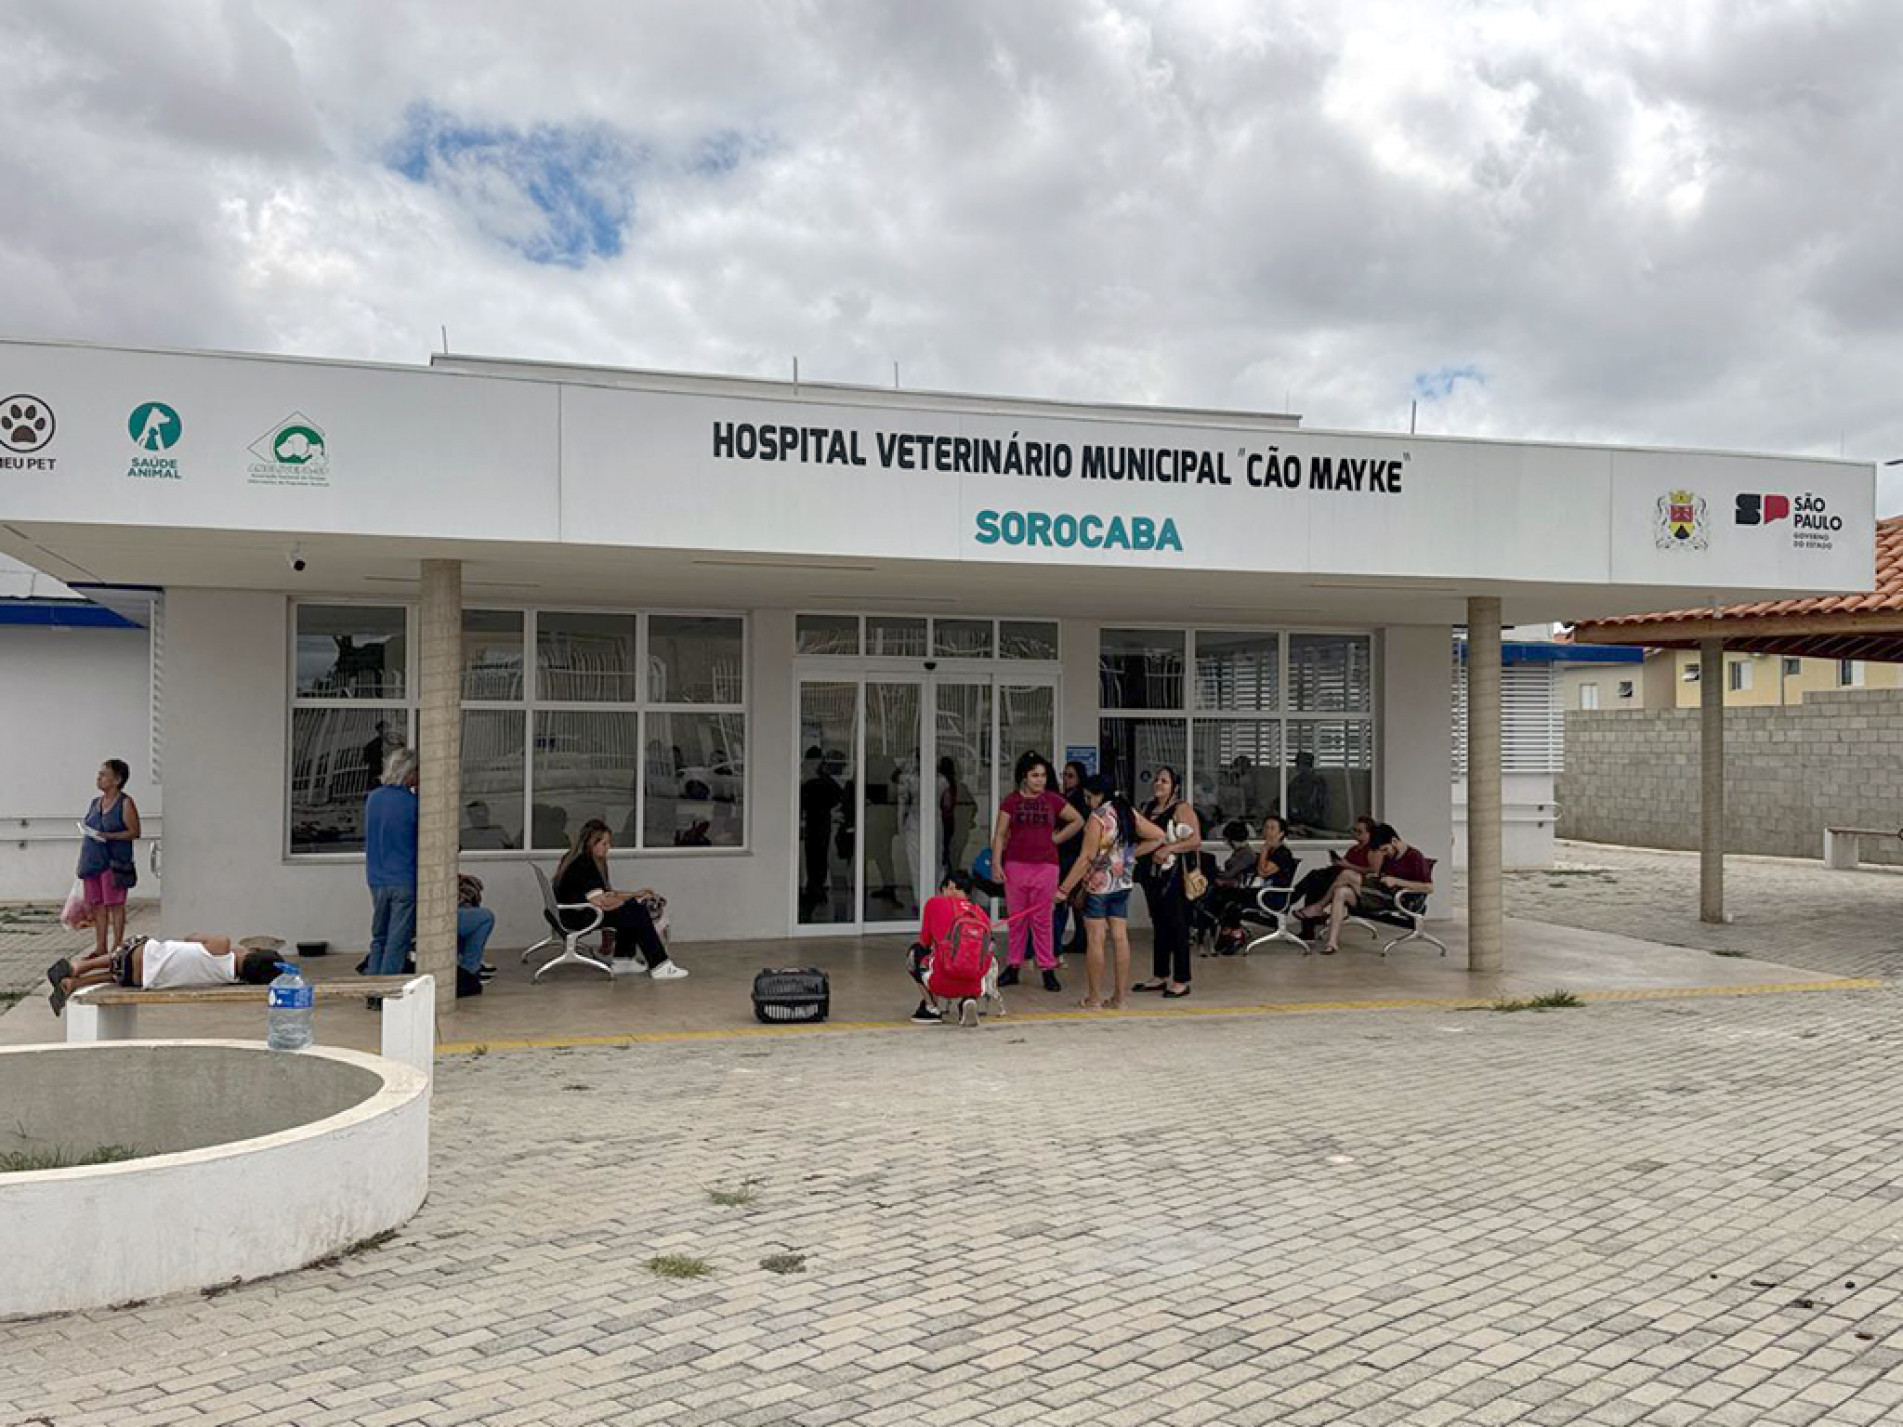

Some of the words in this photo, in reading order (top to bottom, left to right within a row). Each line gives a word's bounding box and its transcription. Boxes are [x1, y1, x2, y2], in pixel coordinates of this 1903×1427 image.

[131, 455, 178, 469] SAÚDE
[713, 421, 867, 467] HOSPITAL
[875, 430, 1073, 480] VETERINÁRIO
[1080, 445, 1233, 486] MUNICIPAL
[27, 458, 56, 471] PET
[128, 467, 182, 480] ANIMAL
[1794, 492, 1826, 514] SÃO
[974, 508, 1184, 553] SOROCABA
[1794, 513, 1843, 532] PAULO
